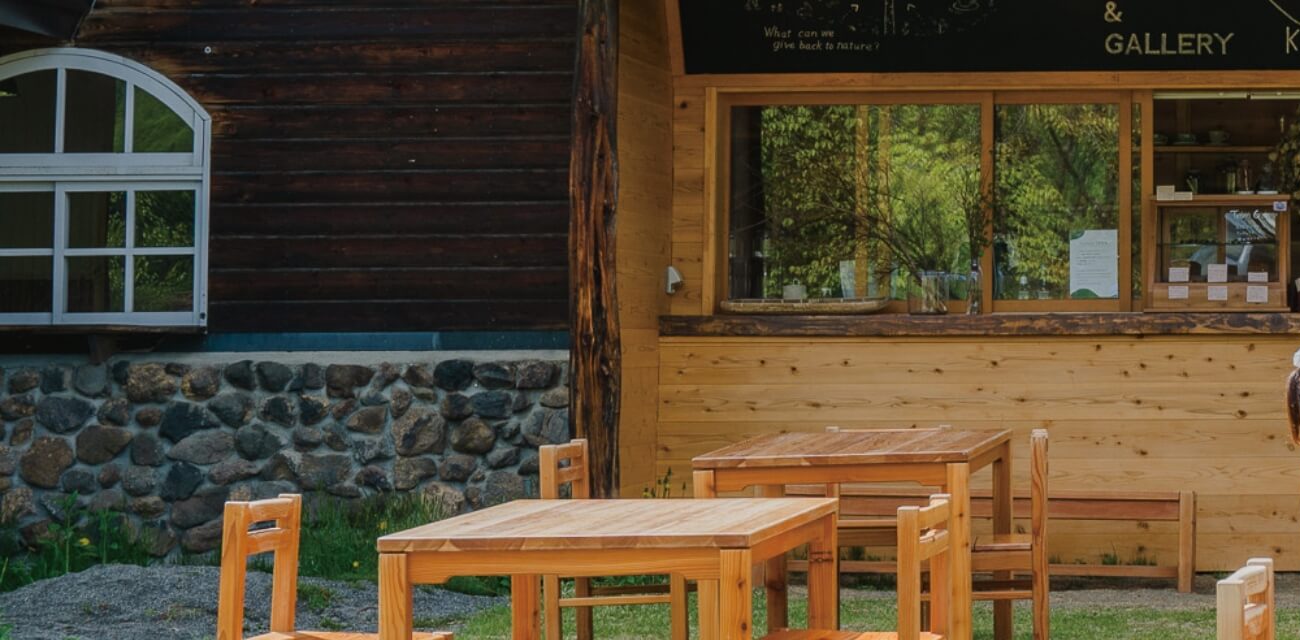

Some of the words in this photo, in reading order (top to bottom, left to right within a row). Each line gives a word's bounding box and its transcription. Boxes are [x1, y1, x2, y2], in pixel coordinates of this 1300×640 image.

[1104, 1, 1122, 22] &
[763, 25, 792, 38] What
[798, 30, 818, 38] can
[821, 30, 834, 38] we
[772, 41, 795, 52] give
[799, 40, 821, 50] back
[825, 42, 834, 50] to
[1105, 33, 1234, 55] GALLERY
